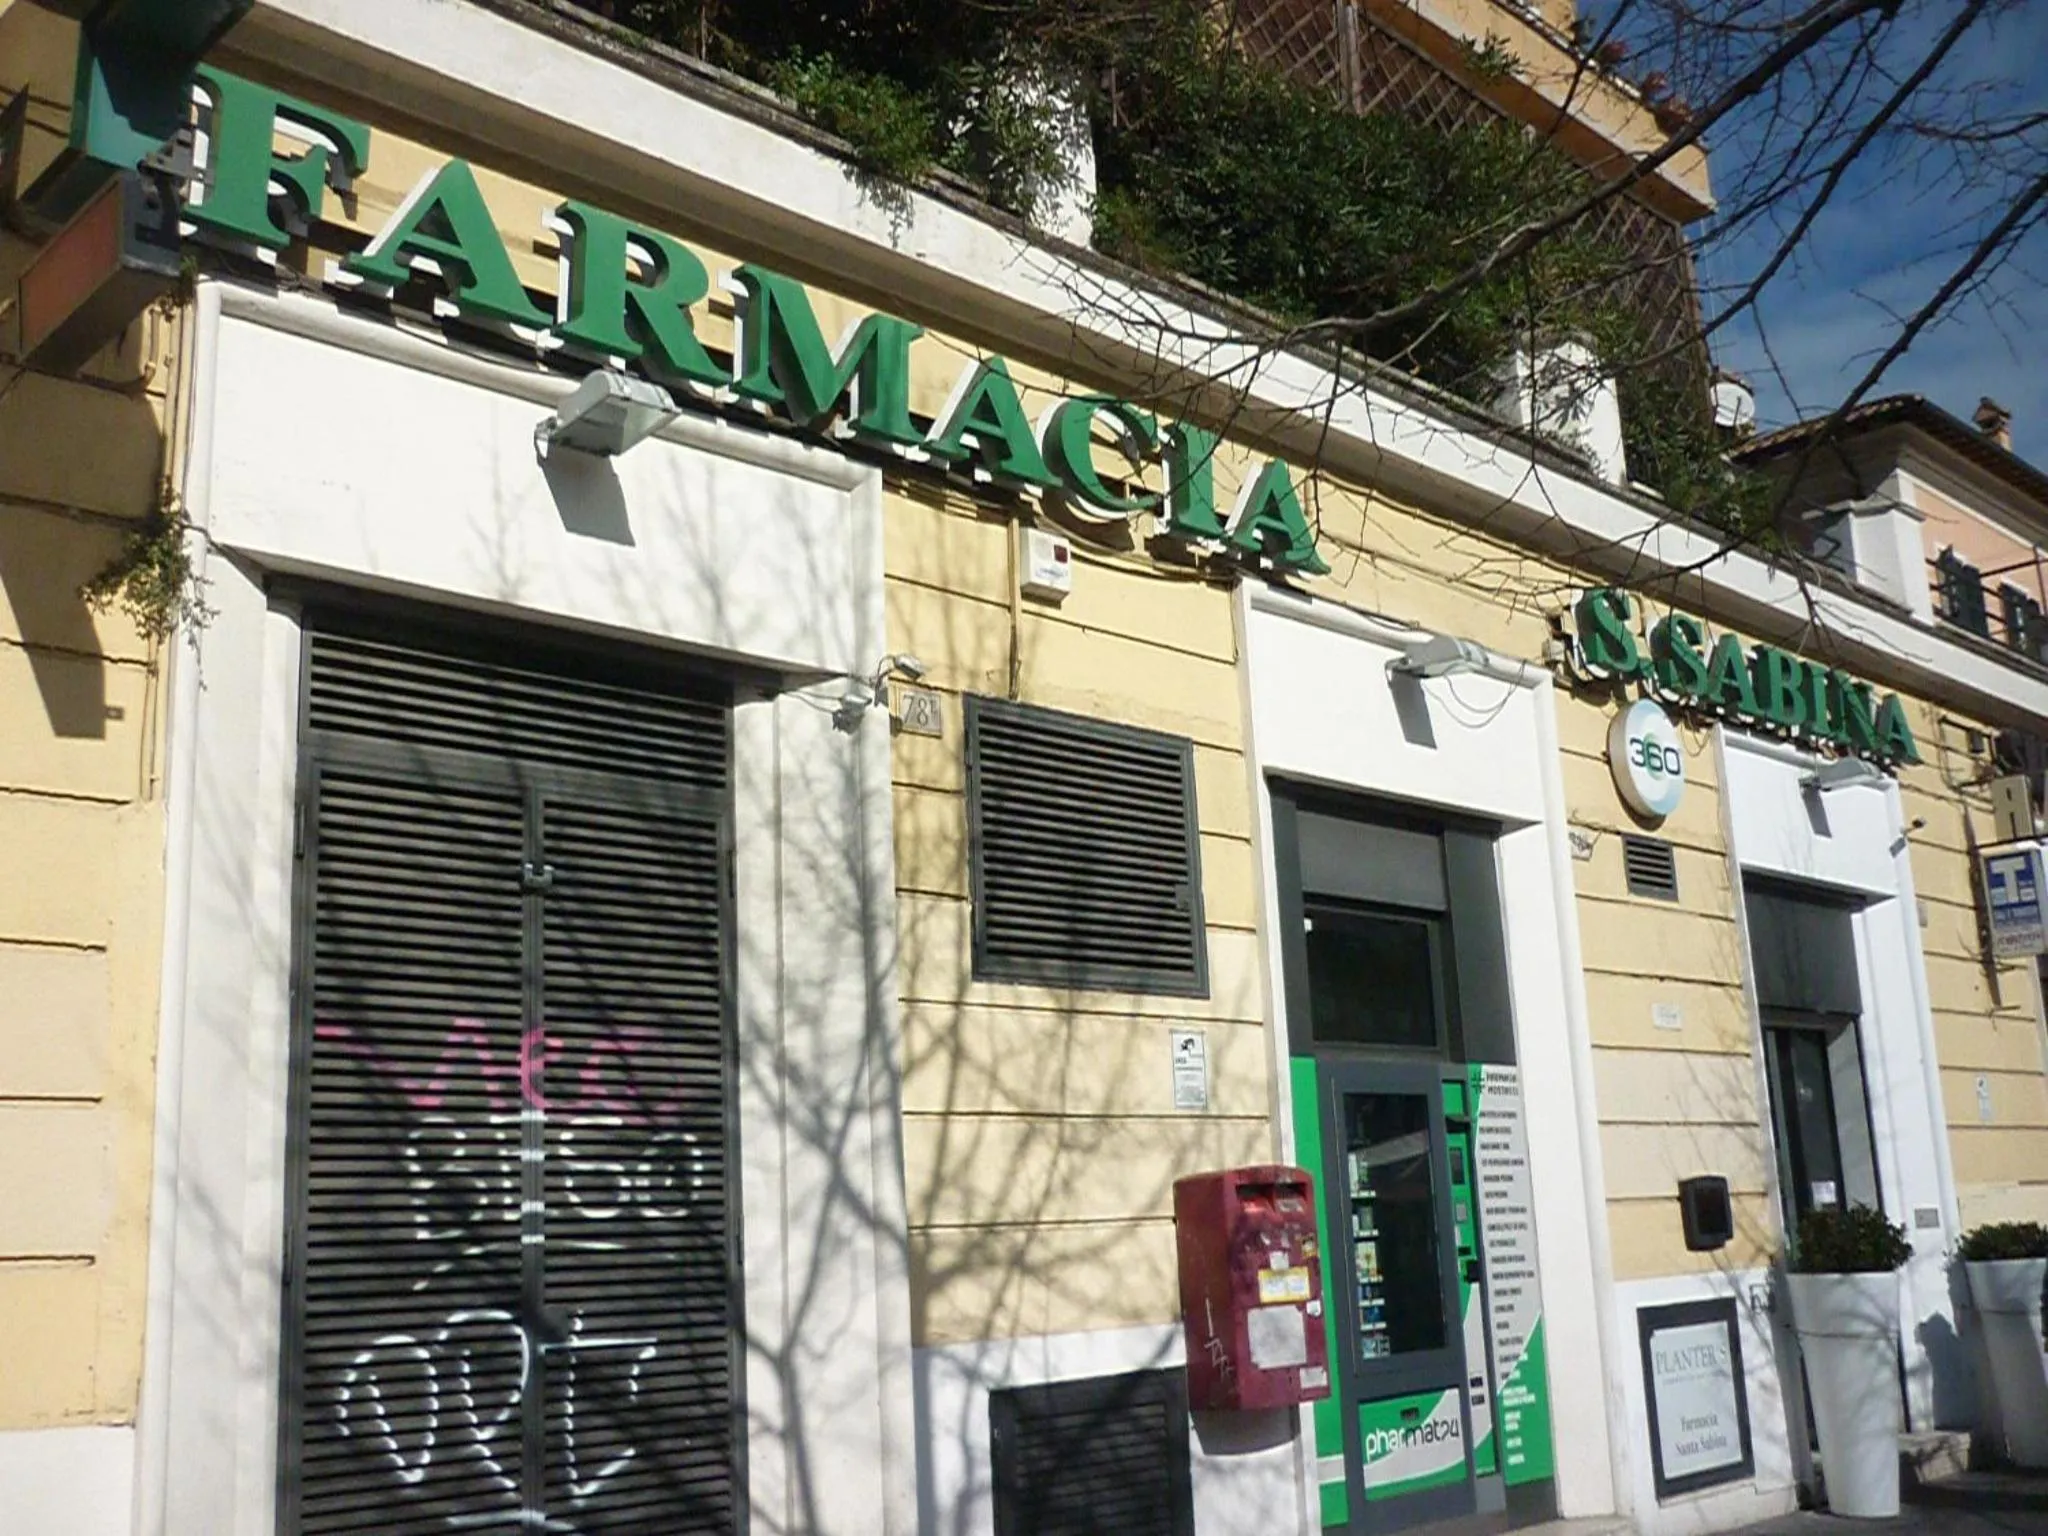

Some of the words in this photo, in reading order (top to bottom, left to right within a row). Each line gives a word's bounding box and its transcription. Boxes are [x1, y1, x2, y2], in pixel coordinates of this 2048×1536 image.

[180, 61, 1330, 574] FARMACIA
[1629, 737, 1681, 776] 360
[1650, 612, 1923, 765] SABINA
